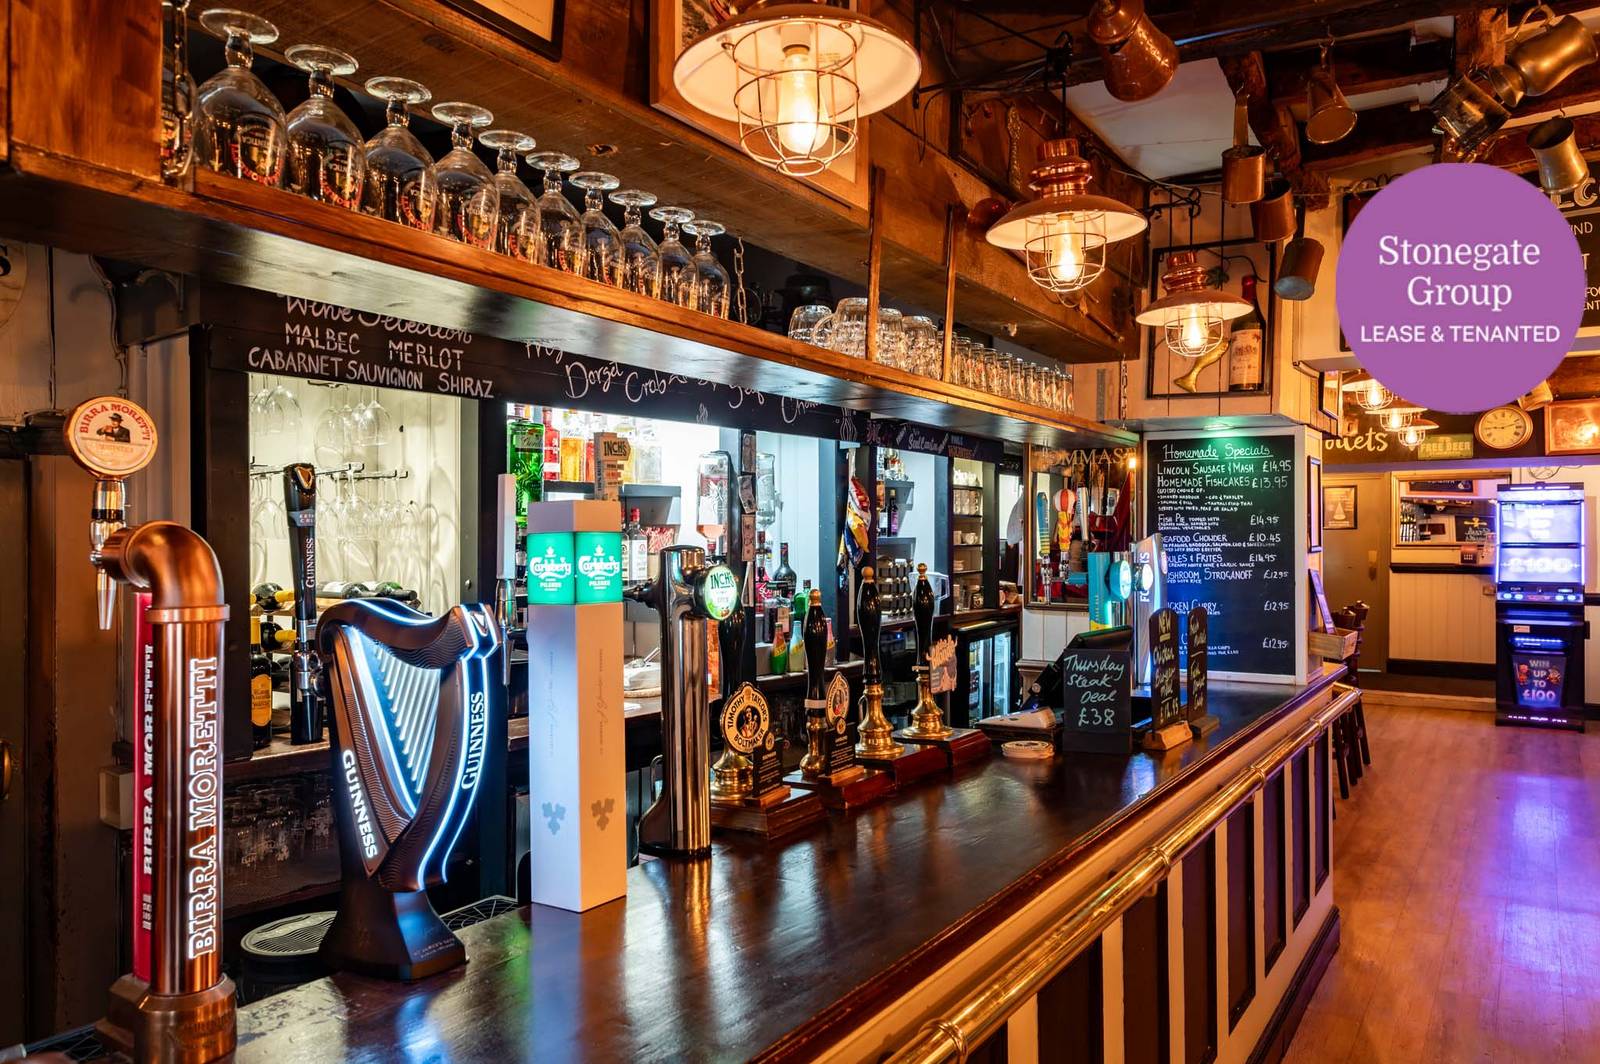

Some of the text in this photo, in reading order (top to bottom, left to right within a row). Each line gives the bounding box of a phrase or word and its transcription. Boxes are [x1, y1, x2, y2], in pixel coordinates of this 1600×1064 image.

[285, 322, 465, 371] MALBEC MERLOT
[249, 347, 495, 399] CABARNET SAUVIGNON SHIRAZ
[625, 370, 667, 402] Crab
[79, 403, 151, 441] BIRRA MORETTI
[1325, 427, 1388, 452] oilets
[1163, 443, 1271, 460] Homemade Specials
[1157, 463, 1190, 475] LINCOLN
[1192, 462, 1226, 474] SAUSAGE
[1233, 462, 1254, 474] MASH
[1262, 460, 1292, 473] £14.95
[1157, 475, 1289, 489] HOMEMADE FISHCAKES £13.95
[1158, 514, 1172, 522] FISH
[1176, 513, 1185, 522] PIE
[1250, 515, 1280, 526] £14.95
[1161, 532, 1281, 542] EAFOOD CHOWDER £10.45
[305, 537, 316, 588] GUINNESS
[578, 555, 620, 578] Carlsberg
[1196, 553, 1222, 562] FRITES
[1509, 557, 1573, 574] £100
[530, 556, 572, 580] Carlsberg
[1204, 568, 1254, 580] STROGANOFF
[1264, 569, 1288, 579] £12.95
[1264, 601, 1289, 612] £12.95
[1263, 638, 1288, 649] £12.95
[1064, 654, 1124, 681] Thursday
[1529, 660, 1550, 668] WIN
[1067, 674, 1112, 688] Steak
[1523, 689, 1556, 701] £100
[728, 693, 768, 729] TIMOTHY TAYLOR'S
[1078, 707, 1115, 727] £38
[461, 691, 485, 790] GUINNESS
[734, 728, 764, 748] BOLTMAKER
[143, 644, 154, 876] BIRRA MORETTI
[188, 656, 218, 960] BIRRA MORETTI
[342, 750, 378, 858] GUINNESS
